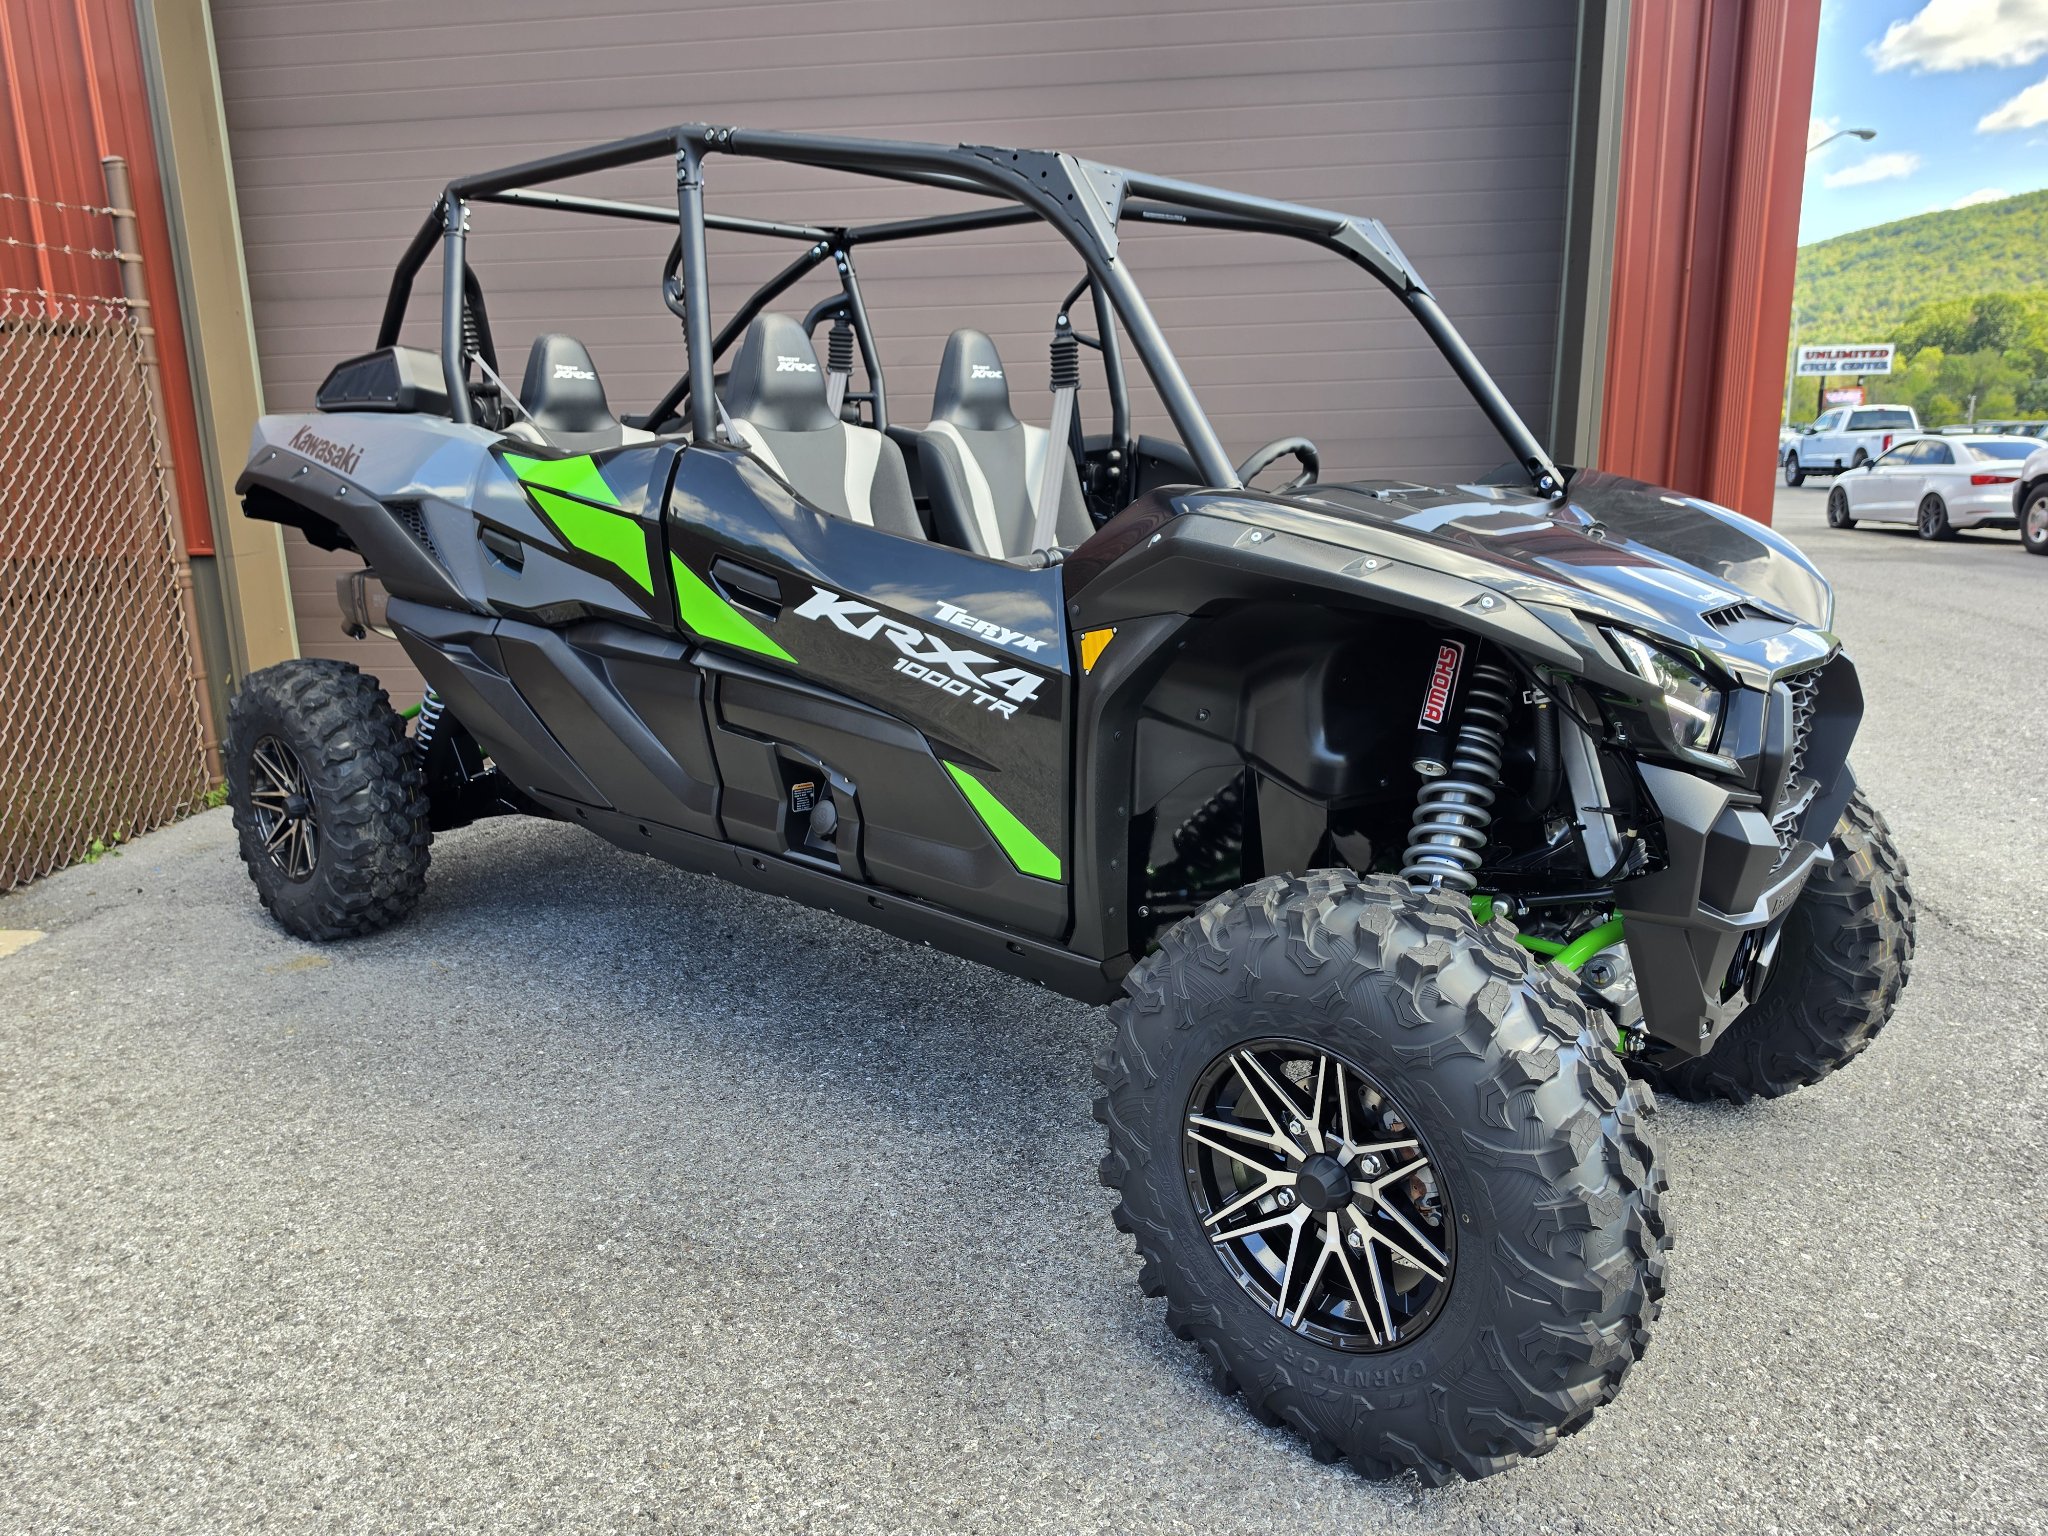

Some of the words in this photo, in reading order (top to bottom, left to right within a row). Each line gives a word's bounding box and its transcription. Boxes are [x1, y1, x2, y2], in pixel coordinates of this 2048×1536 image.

[776, 361, 817, 373] KRX
[1800, 362, 1837, 372] CYCLE
[1841, 361, 1889, 371] CENTER
[1805, 350, 1889, 359] UNLIMITED
[288, 424, 365, 475] Kawasaki
[793, 585, 1046, 702] KRX4
[931, 600, 1049, 653] TERYX
[1423, 645, 1458, 724] SHOWA
[1263, 1334, 1427, 1388] CARNIVORE
